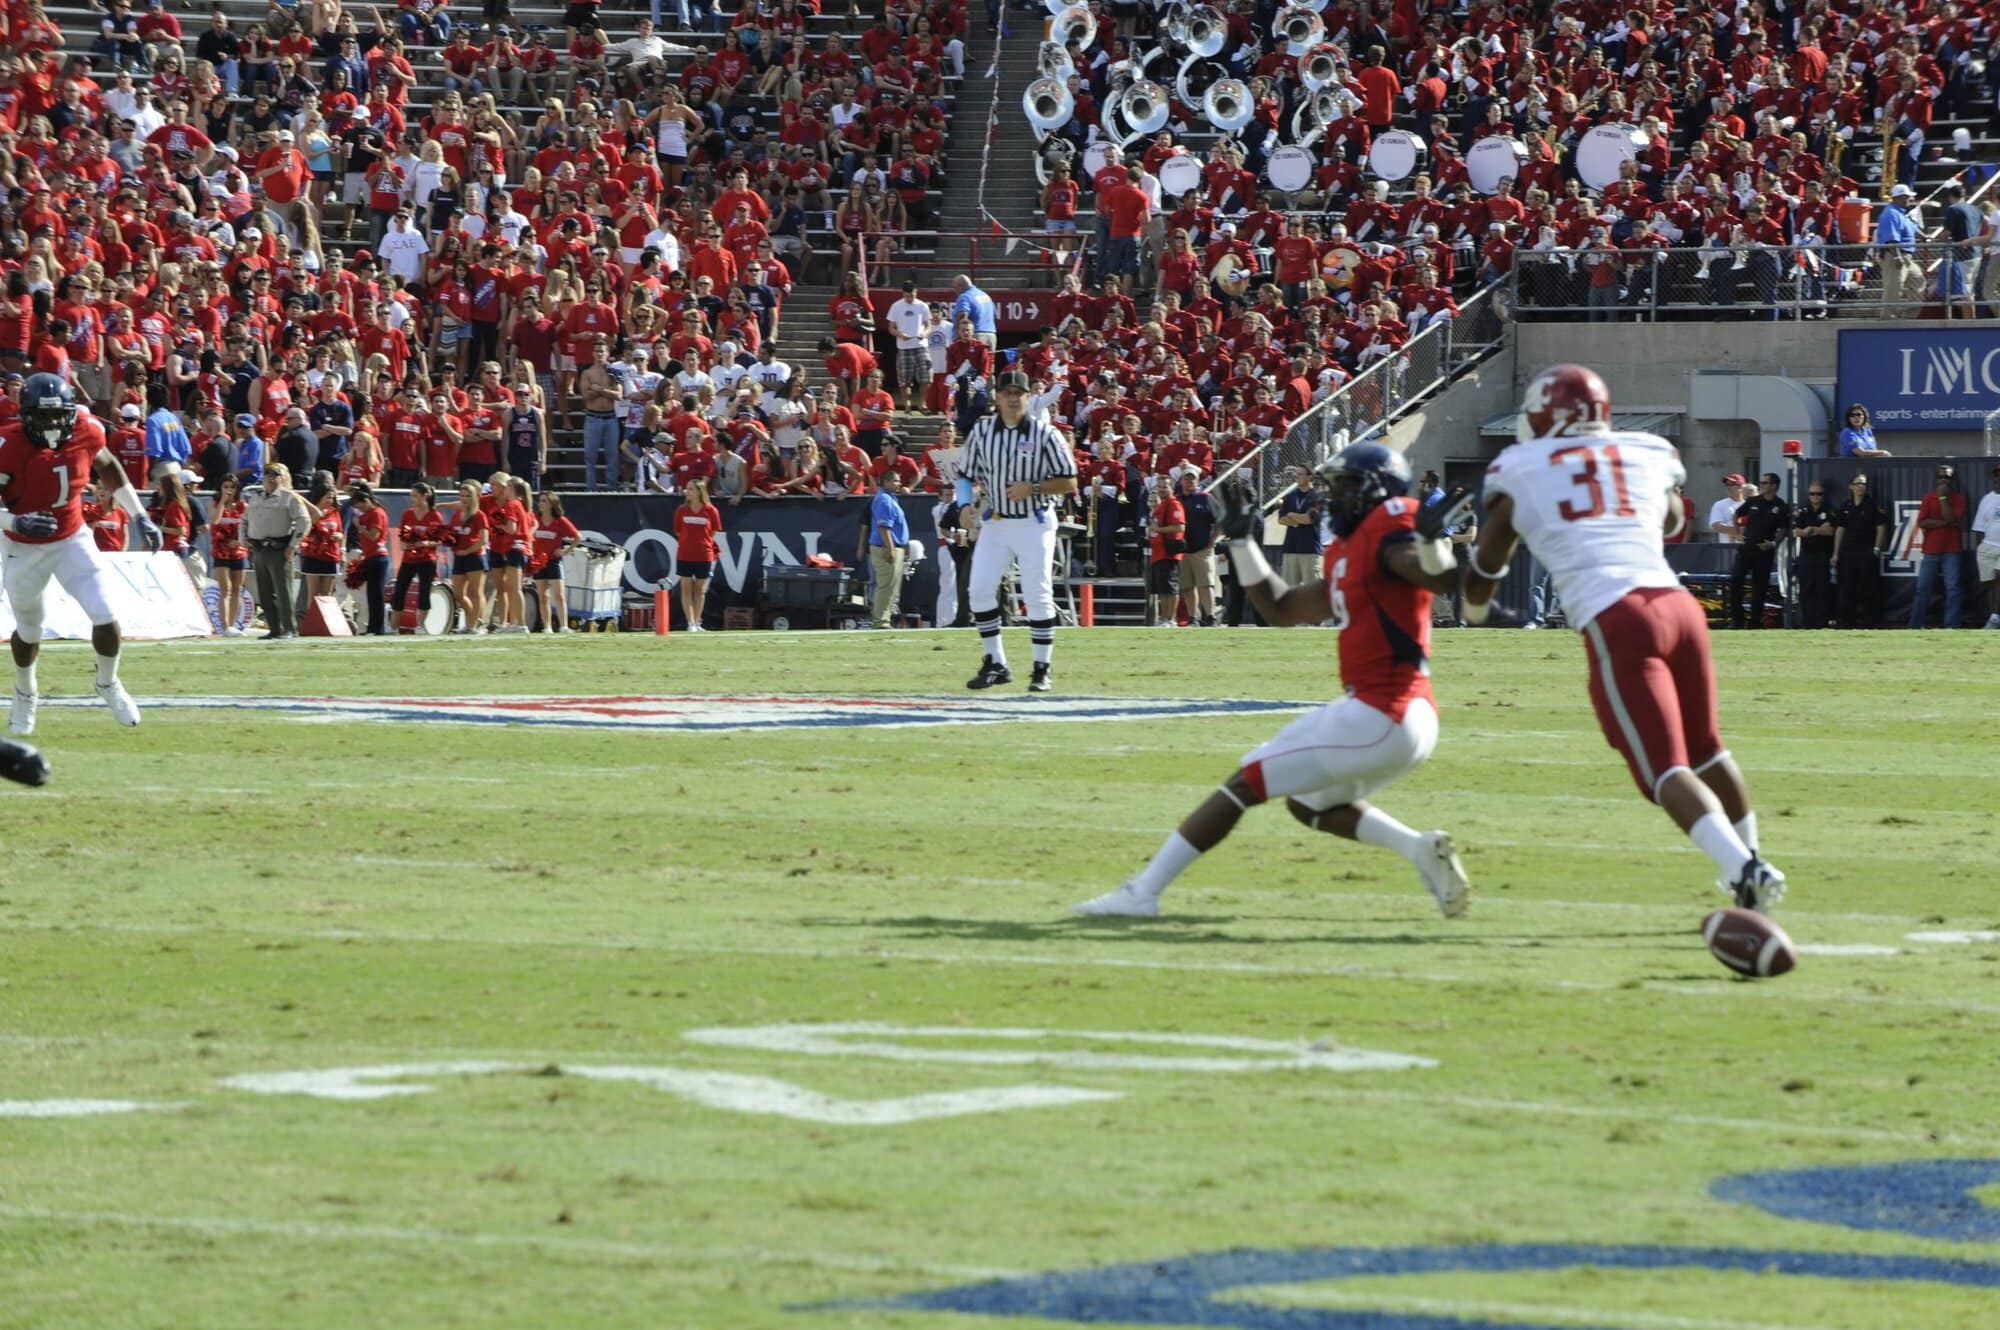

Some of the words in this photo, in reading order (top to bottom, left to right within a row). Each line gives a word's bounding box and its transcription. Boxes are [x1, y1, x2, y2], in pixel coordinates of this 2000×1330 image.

[1007, 302, 1022, 320] 10
[1577, 400, 1604, 422] 31
[1875, 409, 1912, 422] sports
[52, 465, 69, 508] 1
[1549, 444, 1636, 522] 31
